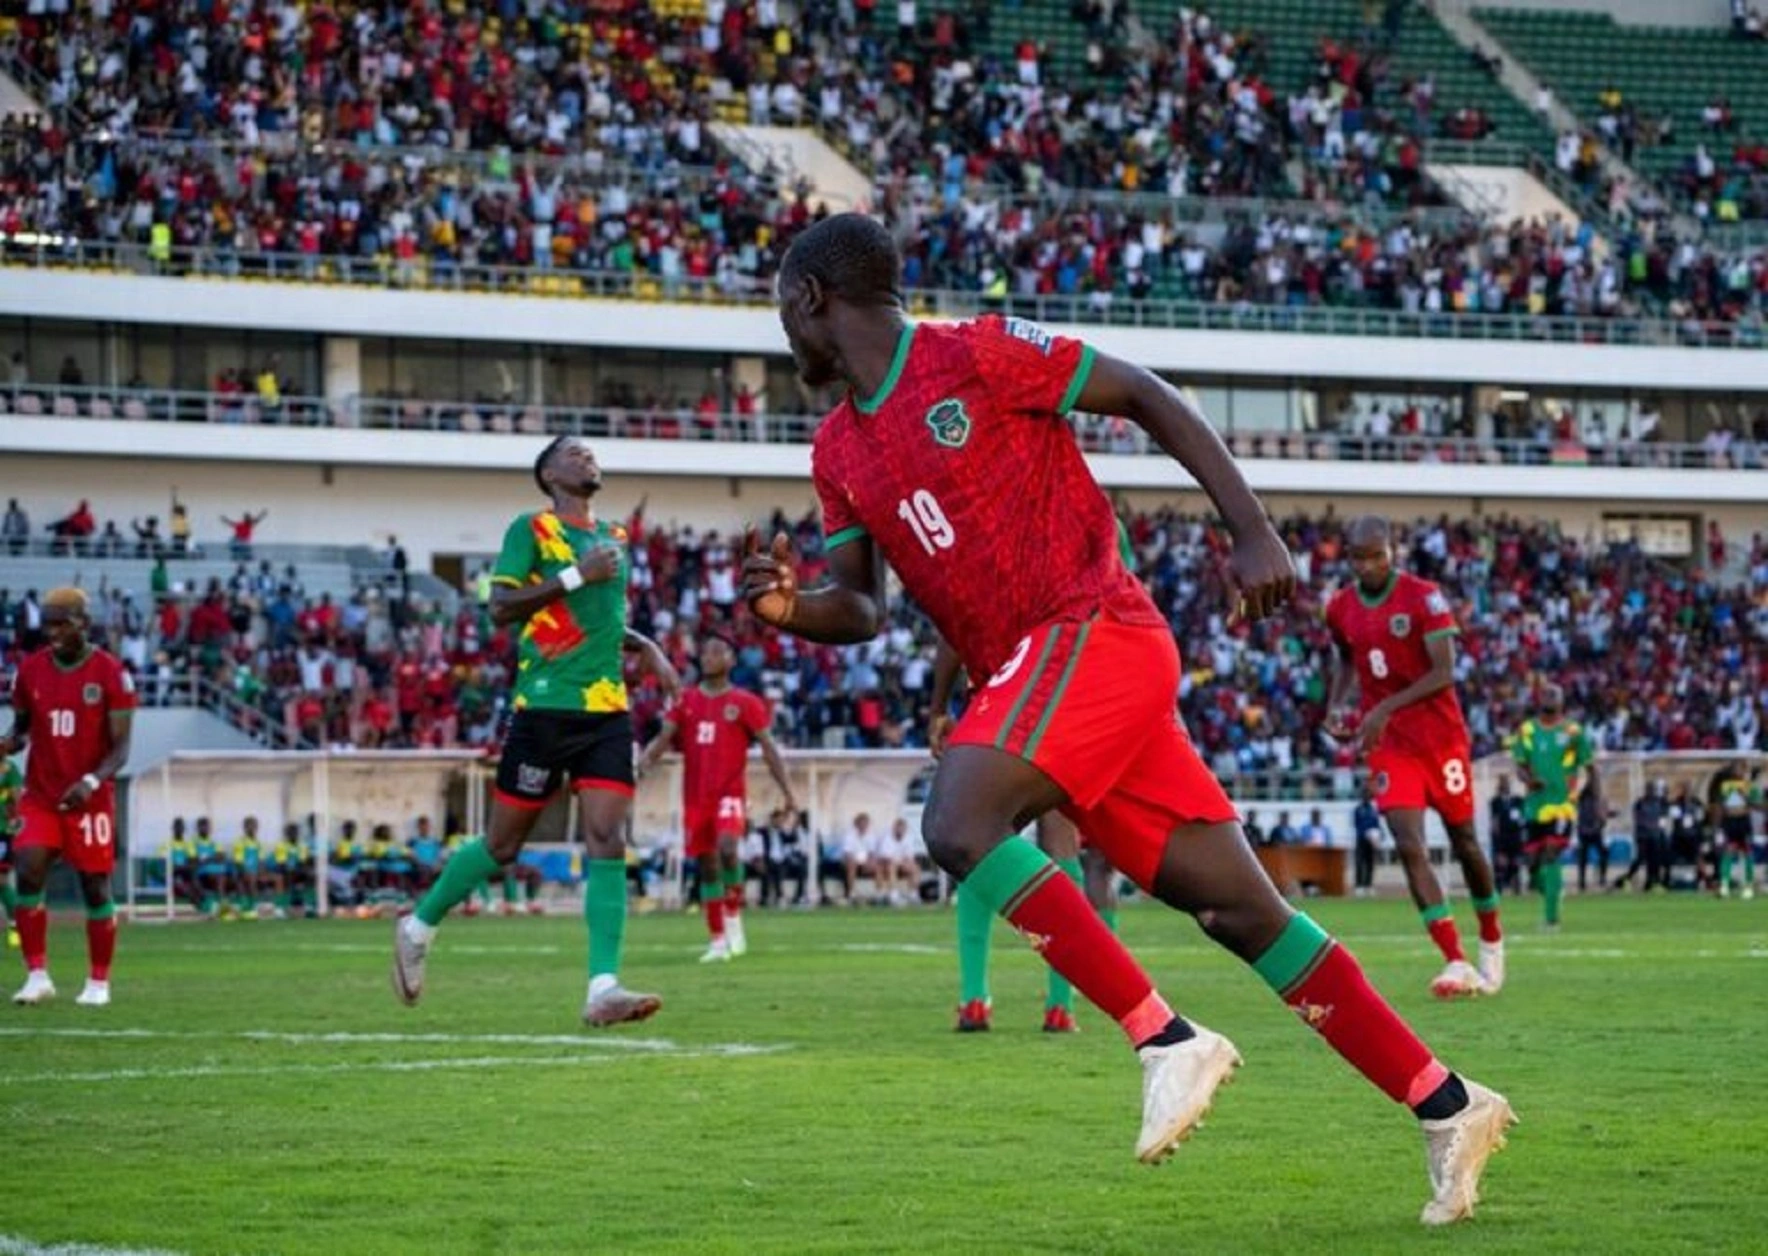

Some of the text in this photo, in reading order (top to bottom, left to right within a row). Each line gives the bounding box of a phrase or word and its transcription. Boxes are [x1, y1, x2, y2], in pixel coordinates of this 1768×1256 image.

[897, 489, 955, 557] 19
[1369, 648, 1389, 679] 8
[49, 709, 75, 737] 10
[1442, 758, 1467, 794] 8
[79, 811, 111, 846] 10
